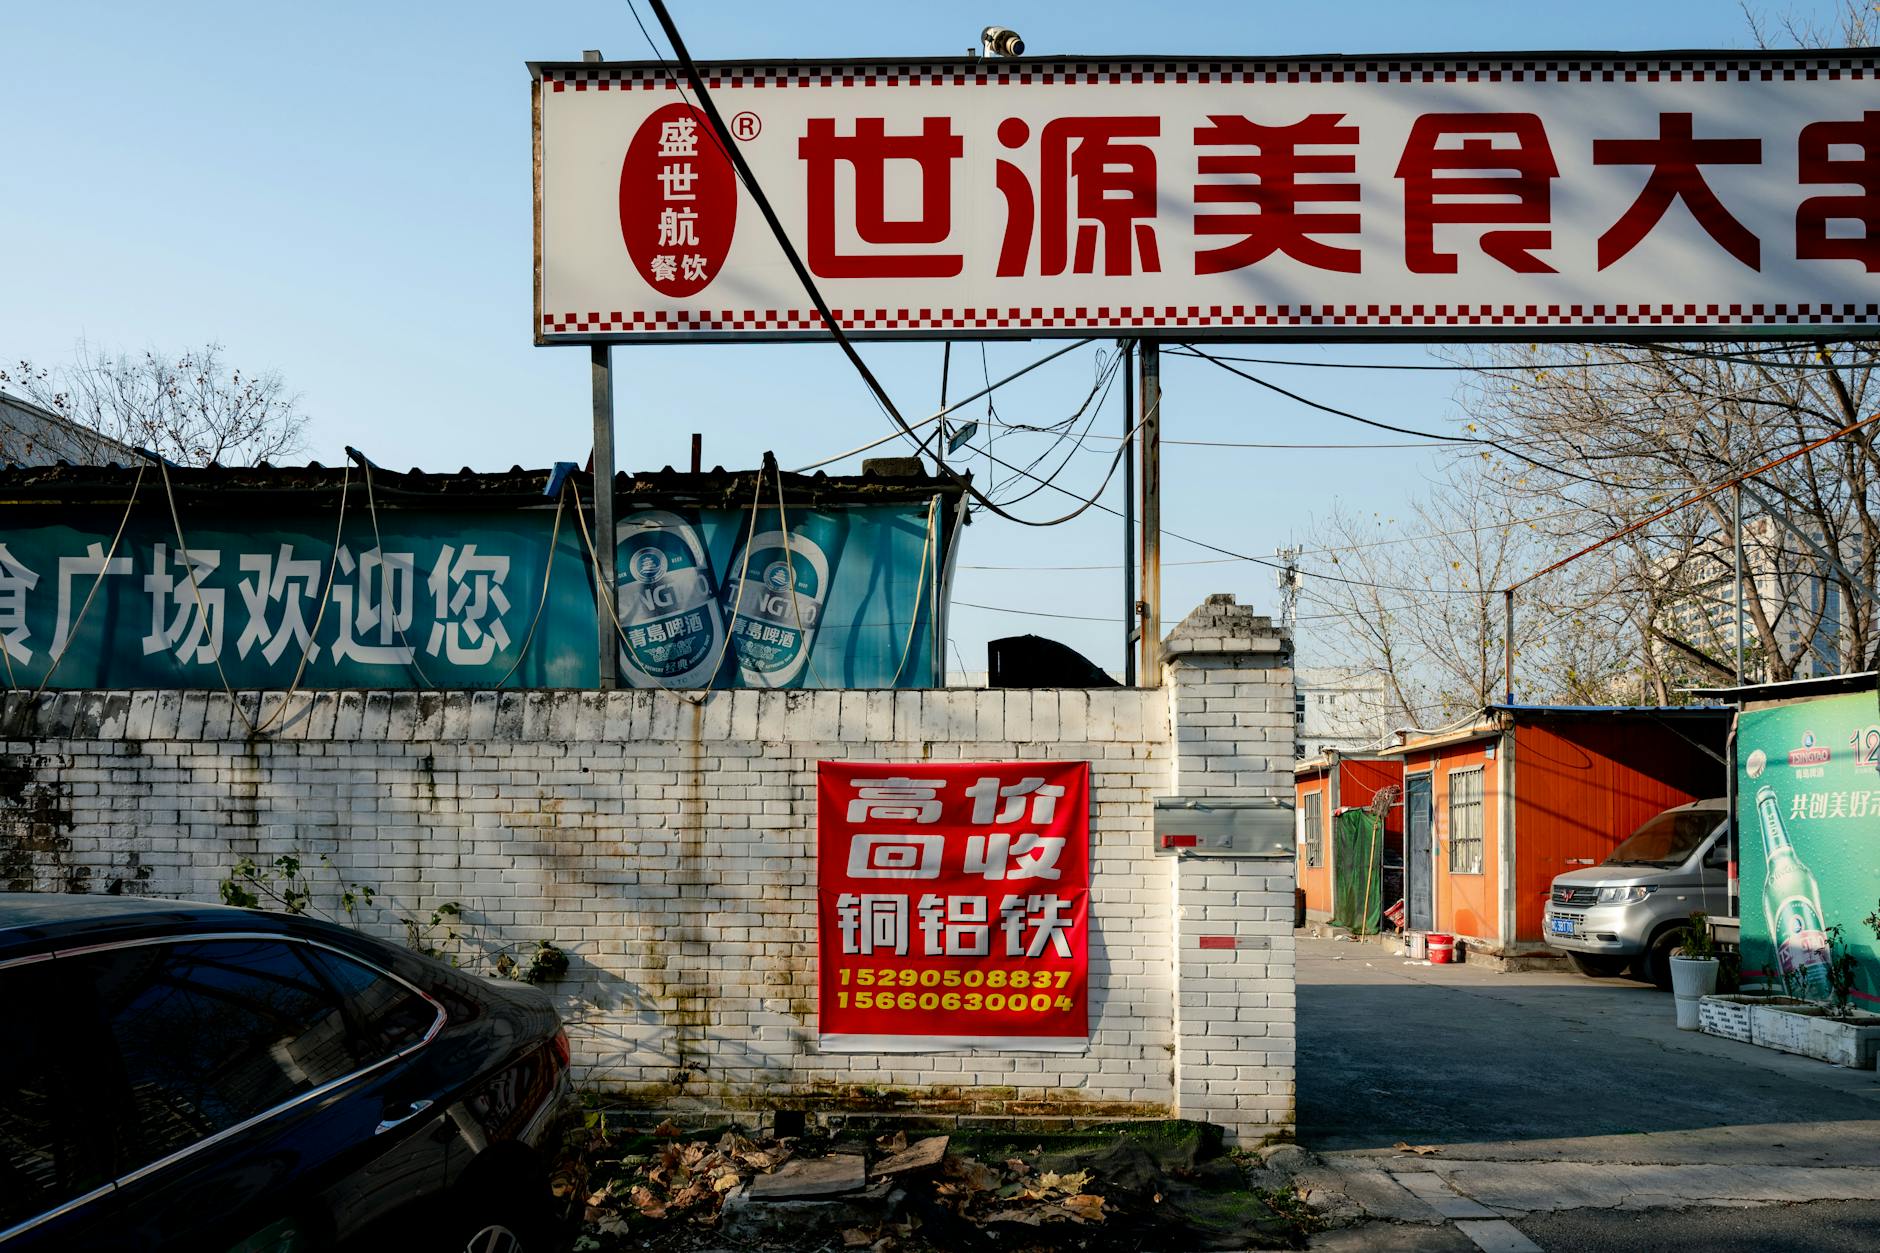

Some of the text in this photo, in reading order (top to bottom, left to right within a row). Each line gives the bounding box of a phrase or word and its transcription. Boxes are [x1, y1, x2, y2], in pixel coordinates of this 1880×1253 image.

[657, 116, 699, 247] 盛世航
[650, 254, 708, 283] 餐饮
[1791, 750, 1828, 764] TSINGTAO
[846, 776, 1066, 825] 高价
[846, 833, 1066, 881] 回收
[836, 893, 1073, 958] 铜铝铁
[838, 968, 1072, 989] 15290508837
[837, 991, 1073, 1013] 15660630004
